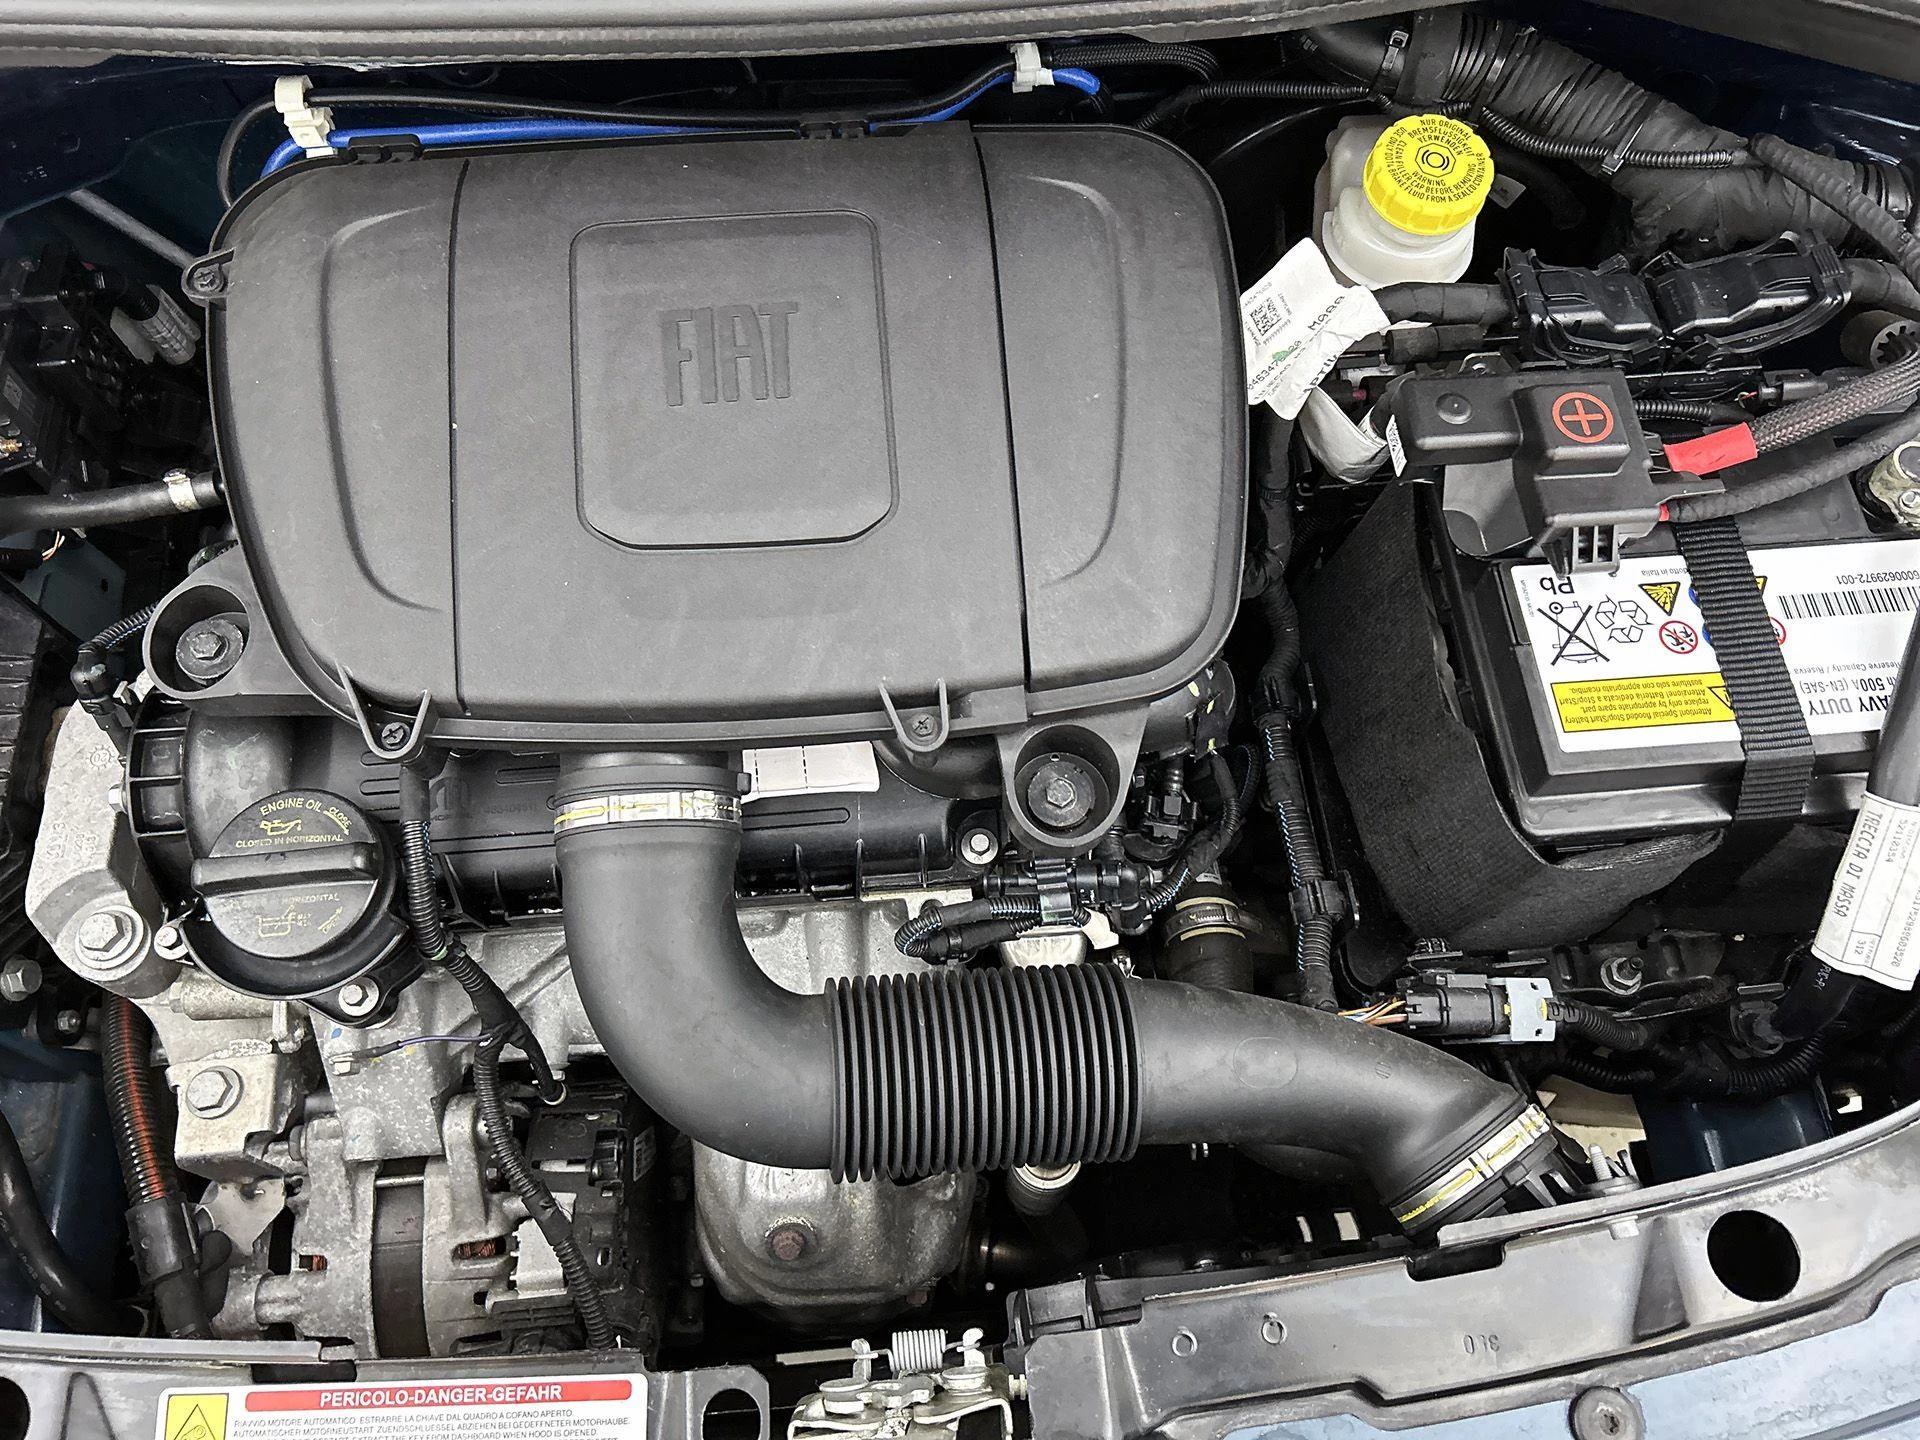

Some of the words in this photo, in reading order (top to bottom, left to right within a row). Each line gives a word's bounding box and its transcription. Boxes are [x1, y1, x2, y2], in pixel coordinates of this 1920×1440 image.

[1394, 127, 1407, 138] USE
[1439, 120, 1471, 140] ORIGINAL
[1417, 135, 1463, 155] VERWENDEN
[1474, 153, 1485, 187] CONTAINER
[1388, 168, 1406, 188] BRAKE
[1395, 161, 1412, 181] FILLER
[1410, 180, 1424, 190] CAP
[1426, 185, 1454, 195] BEFORE
[1453, 164, 1476, 191] REMOVING
[1412, 171, 1446, 186] WARNING
[1404, 186, 1424, 199] FLUID
[1426, 194, 1446, 203] FROM
[1453, 185, 1476, 201] SEALED
[656, 302, 798, 406] FIAT
[1539, 576, 1575, 595] Pb
[1832, 664, 1866, 673] Capacity
[1602, 682, 1640, 692] appropriato
[1671, 679, 1702, 687] sostituire
[1800, 677, 1849, 694] (EN-SAE)
[1604, 693, 1634, 701] dedicata
[1636, 692, 1664, 701] Batteria
[1666, 689, 1706, 698] Attenzione!
[1559, 696, 1596, 706] Stop/Start
[1618, 701, 1657, 710] appropriate
[1658, 700, 1668, 708] by
[1668, 699, 1682, 708] only
[1684, 698, 1709, 706] replace
[1809, 698, 1853, 716] DUTY
[1859, 694, 1890, 712] AVY
[1590, 714, 1625, 722] Stop/Start
[1626, 712, 1652, 720] flooded
[1652, 709, 1678, 718] Special
[1680, 708, 1712, 717] Attention!
[1565, 716, 1590, 724] battery
[260, 798, 304, 816] ENGINE
[306, 799, 322, 812] OIL
[328, 806, 352, 828] CLOSE
[236, 838, 272, 848] CLOSED
[286, 834, 344, 844] HORIZONTAL
[1852, 810, 1883, 862] TRECCIA
[1846, 861, 1864, 880] DI
[1834, 882, 1856, 918] MASSA
[1854, 940, 1867, 956] 312
[320, 1385, 563, 1408] PERICOLO-DANGER-GEFAHR
[268, 1418, 302, 1426] MOTORE
[360, 1416, 402, 1424] ESTRARRE
[416, 1414, 444, 1422] CHIAVE
[463, 1412, 498, 1420] QUADRO
[506, 1410, 540, 1419] COFANO
[234, 1429, 302, 1438] AUTOMATISCHER
[377, 1424, 455, 1434] ZUENDSCHLUESSEL
[457, 1422, 497, 1430] ABZIEHEN
[498, 1421, 512, 1430] BEI
[452, 1432, 500, 1440] DASHBOARD
[502, 1431, 527, 1439] WHEN
[528, 1430, 552, 1438] HOOD
[554, 1429, 562, 1437] IS
